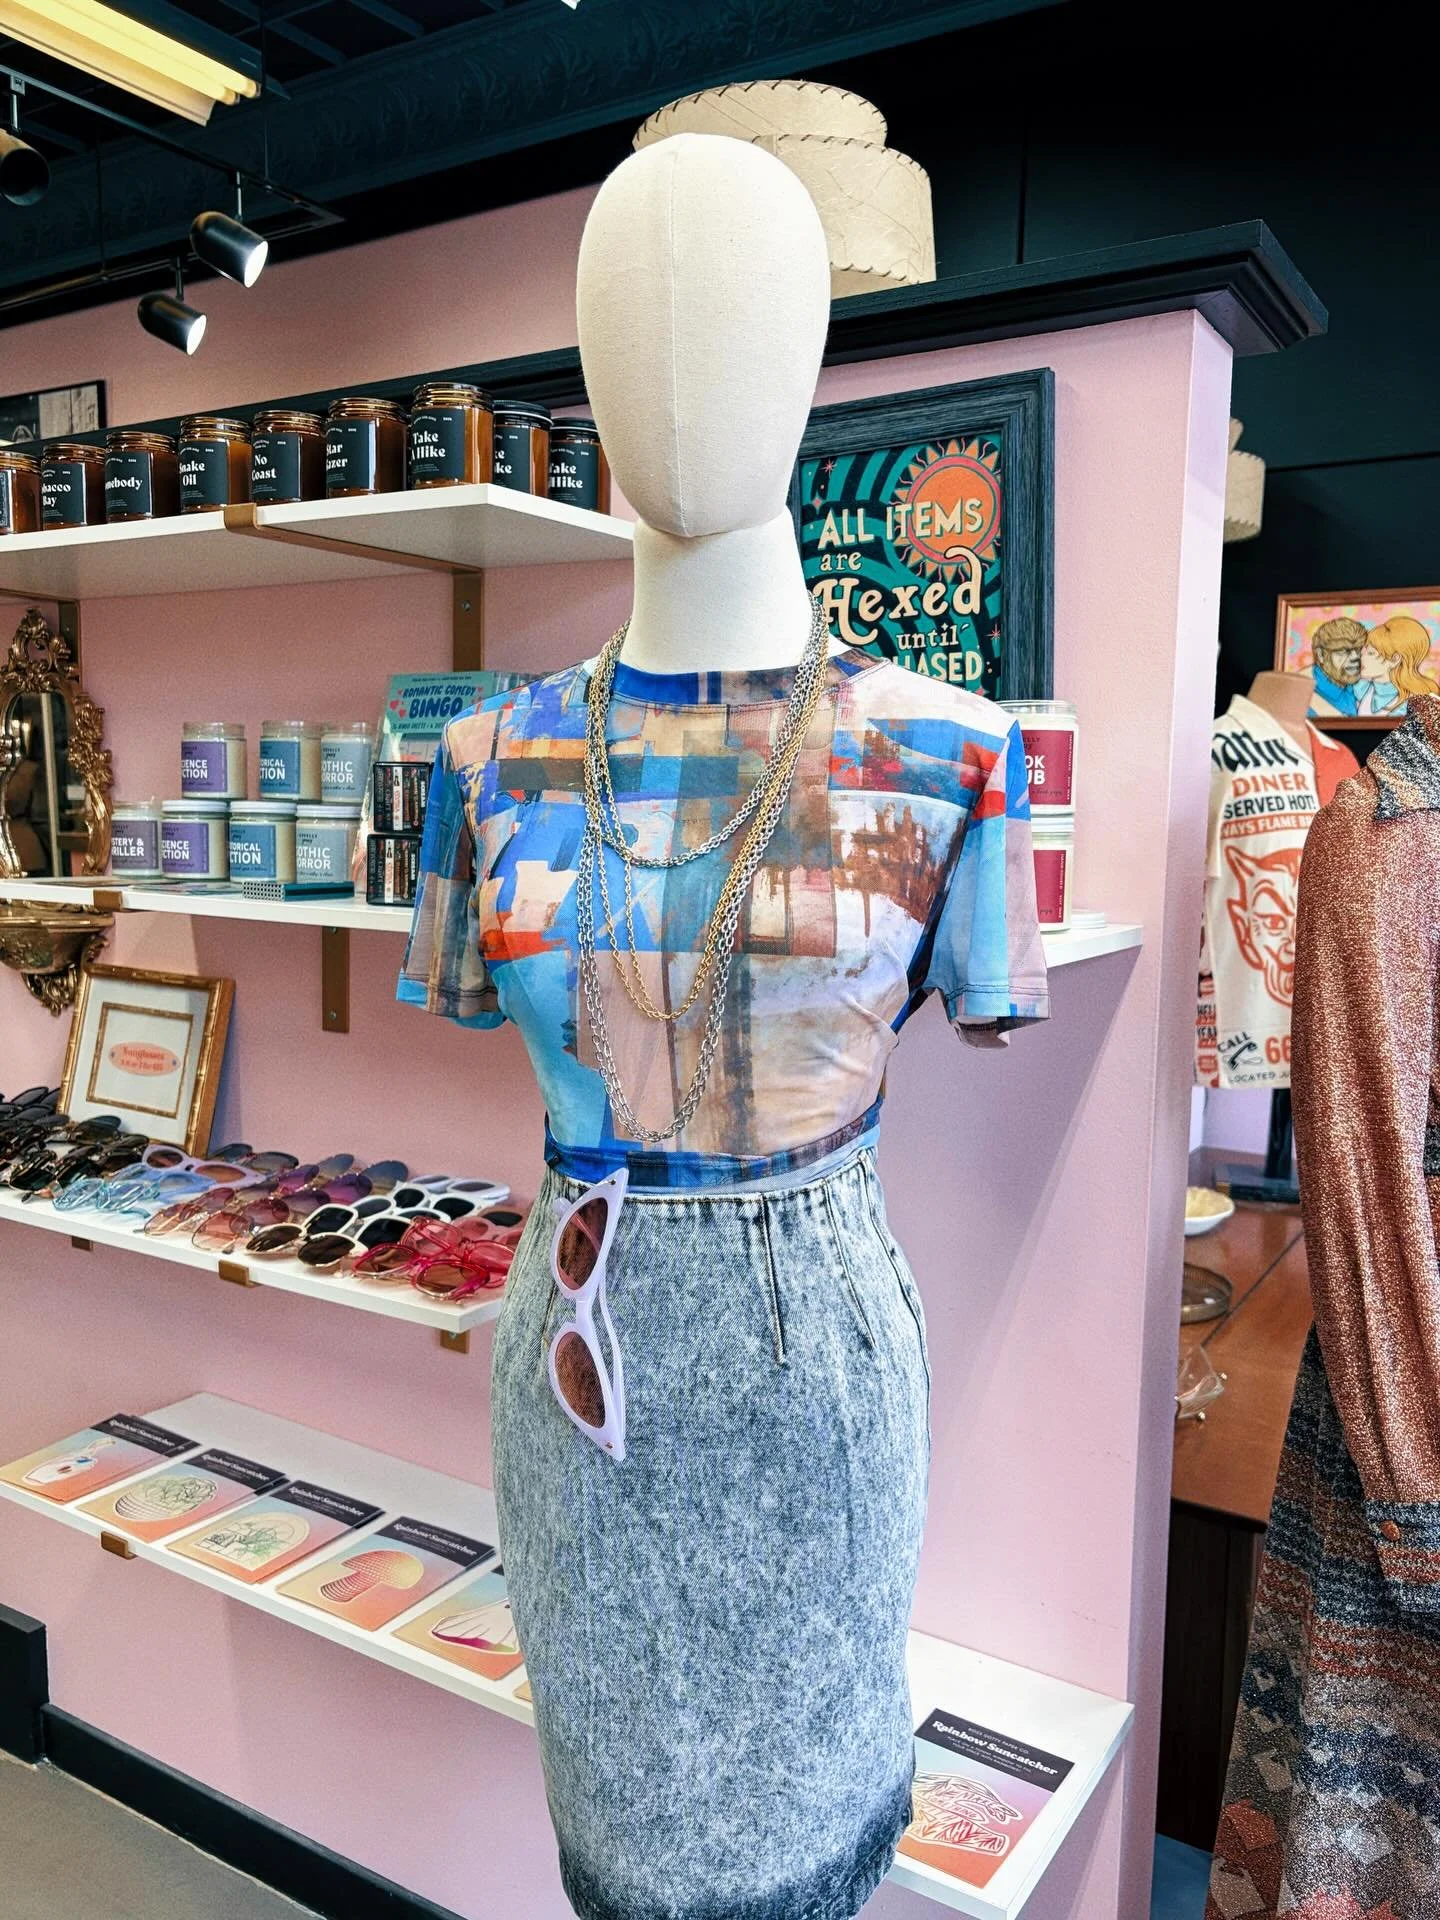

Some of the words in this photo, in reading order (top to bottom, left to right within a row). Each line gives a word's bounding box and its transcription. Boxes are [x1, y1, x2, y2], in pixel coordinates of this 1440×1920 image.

[413, 430, 439, 445] Take
[254, 454, 268, 466] No
[251, 468, 277, 482] Coast
[818, 508, 875, 550] ALL
[886, 496, 984, 541] ITEMS
[820, 551, 863, 573] are
[812, 545, 983, 646] Hexed
[896, 623, 960, 651] until
[892, 650, 984, 682] HASED
[402, 685, 444, 698] ROMANTIC
[445, 684, 477, 696] COMEDY
[409, 696, 463, 719] BINGO
[260, 758, 286, 767] ORICAL
[321, 760, 353, 772] OTHIC
[1025, 755, 1046, 769] OK
[182, 769, 208, 779] CTION
[260, 767, 286, 780] TION
[321, 772, 354, 784] ORROR
[1027, 769, 1046, 785] UB
[1231, 772, 1310, 798] DINER
[1223, 795, 1285, 819] SERVED
[1287, 793, 1317, 811] HOT!
[1257, 814, 1298, 832] FLAME
[112, 837, 134, 846] STERY
[136, 838, 144, 846] &
[112, 846, 145, 857] RILLER
[162, 850, 190, 860] CTION
[229, 851, 262, 865] CTION
[297, 846, 331, 859] OTHIC
[297, 858, 331, 870] ORROR
[1217, 1031, 1251, 1053] CALL
[1227, 1071, 1276, 1084] LOCATED
[932, 1720, 988, 1747] Rainbow
[987, 1742, 1059, 1776] Suncatcher
